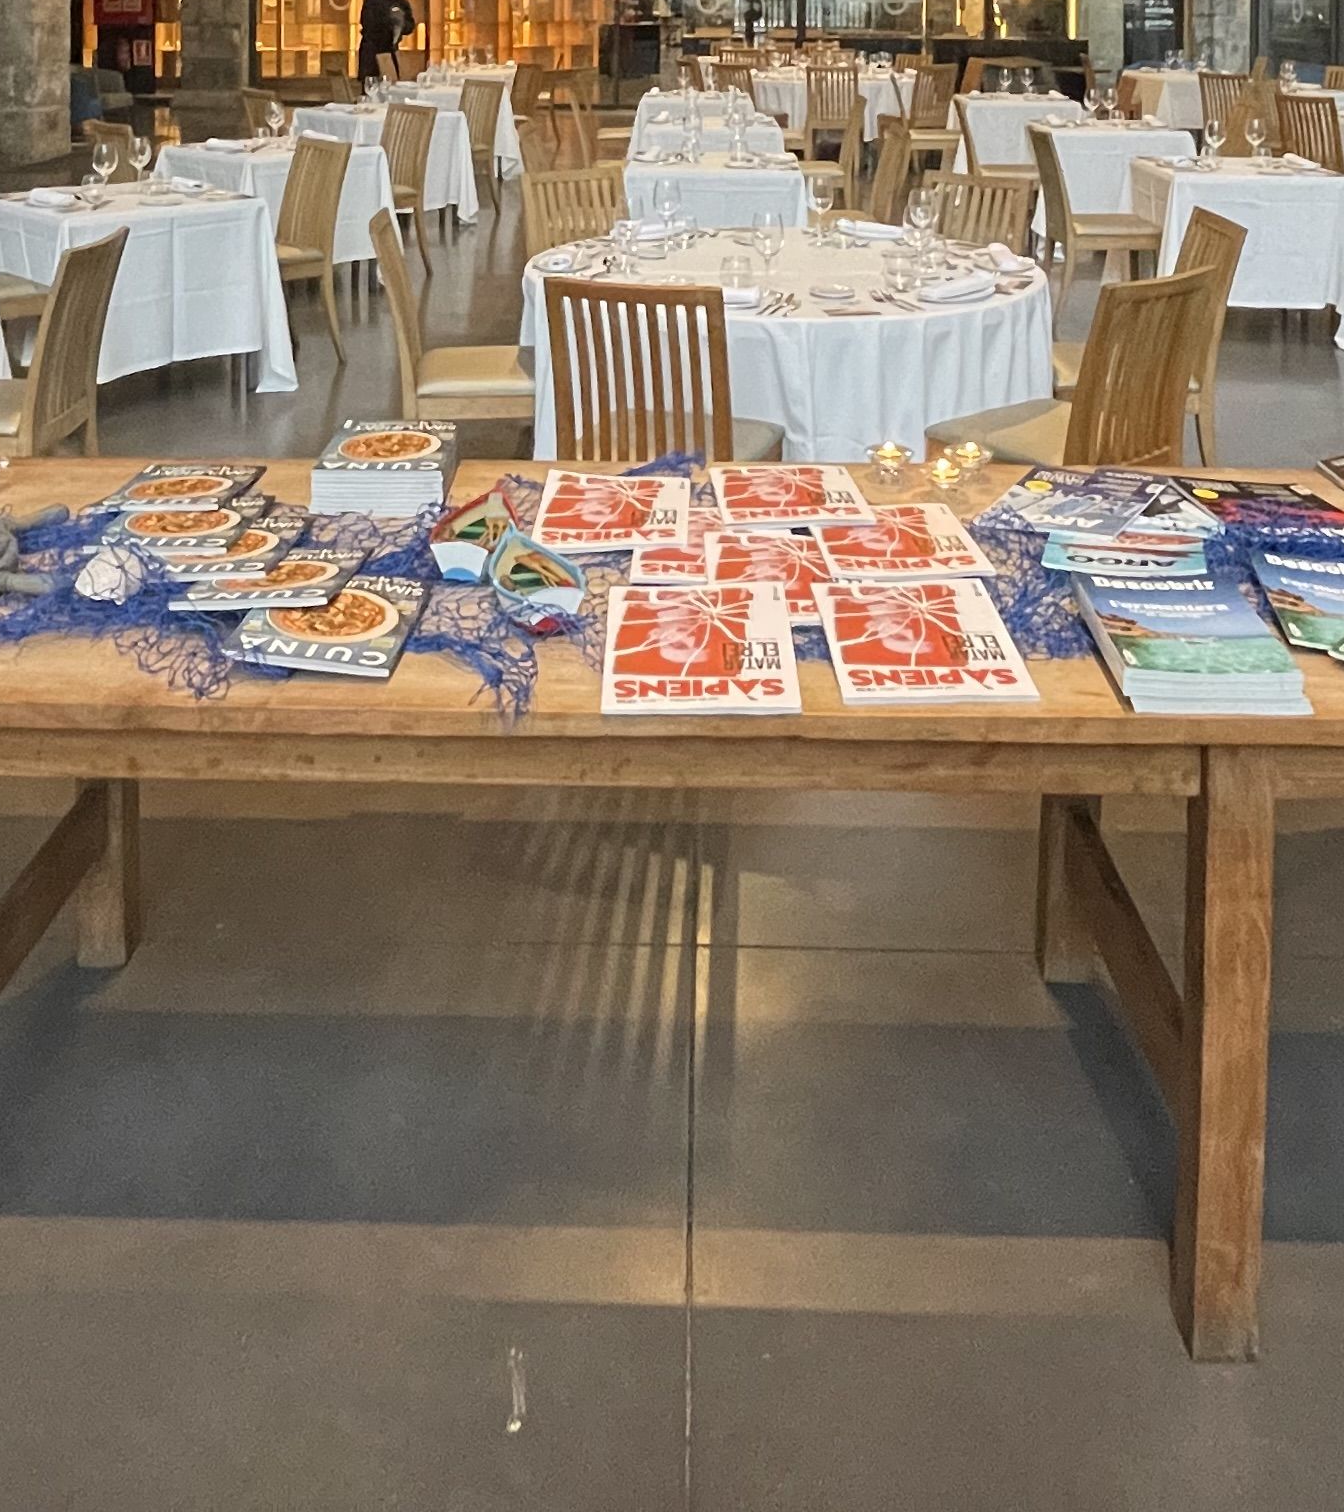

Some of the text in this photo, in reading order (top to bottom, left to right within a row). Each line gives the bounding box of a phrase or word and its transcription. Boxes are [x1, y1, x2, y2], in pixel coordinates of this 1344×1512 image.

[541, 528, 677, 542] SÀPIENS
[834, 555, 977, 571] SÀPIENS
[1091, 576, 1216, 591] Descobrir
[187, 588, 327, 601] CUINA
[973, 634, 999, 648] EL
[238, 633, 389, 667] CUINA
[757, 641, 780, 657] EL
[723, 656, 782, 671] MATAR
[847, 668, 1018, 691] SÀPIENS
[613, 678, 786, 701] SÀPIENS
